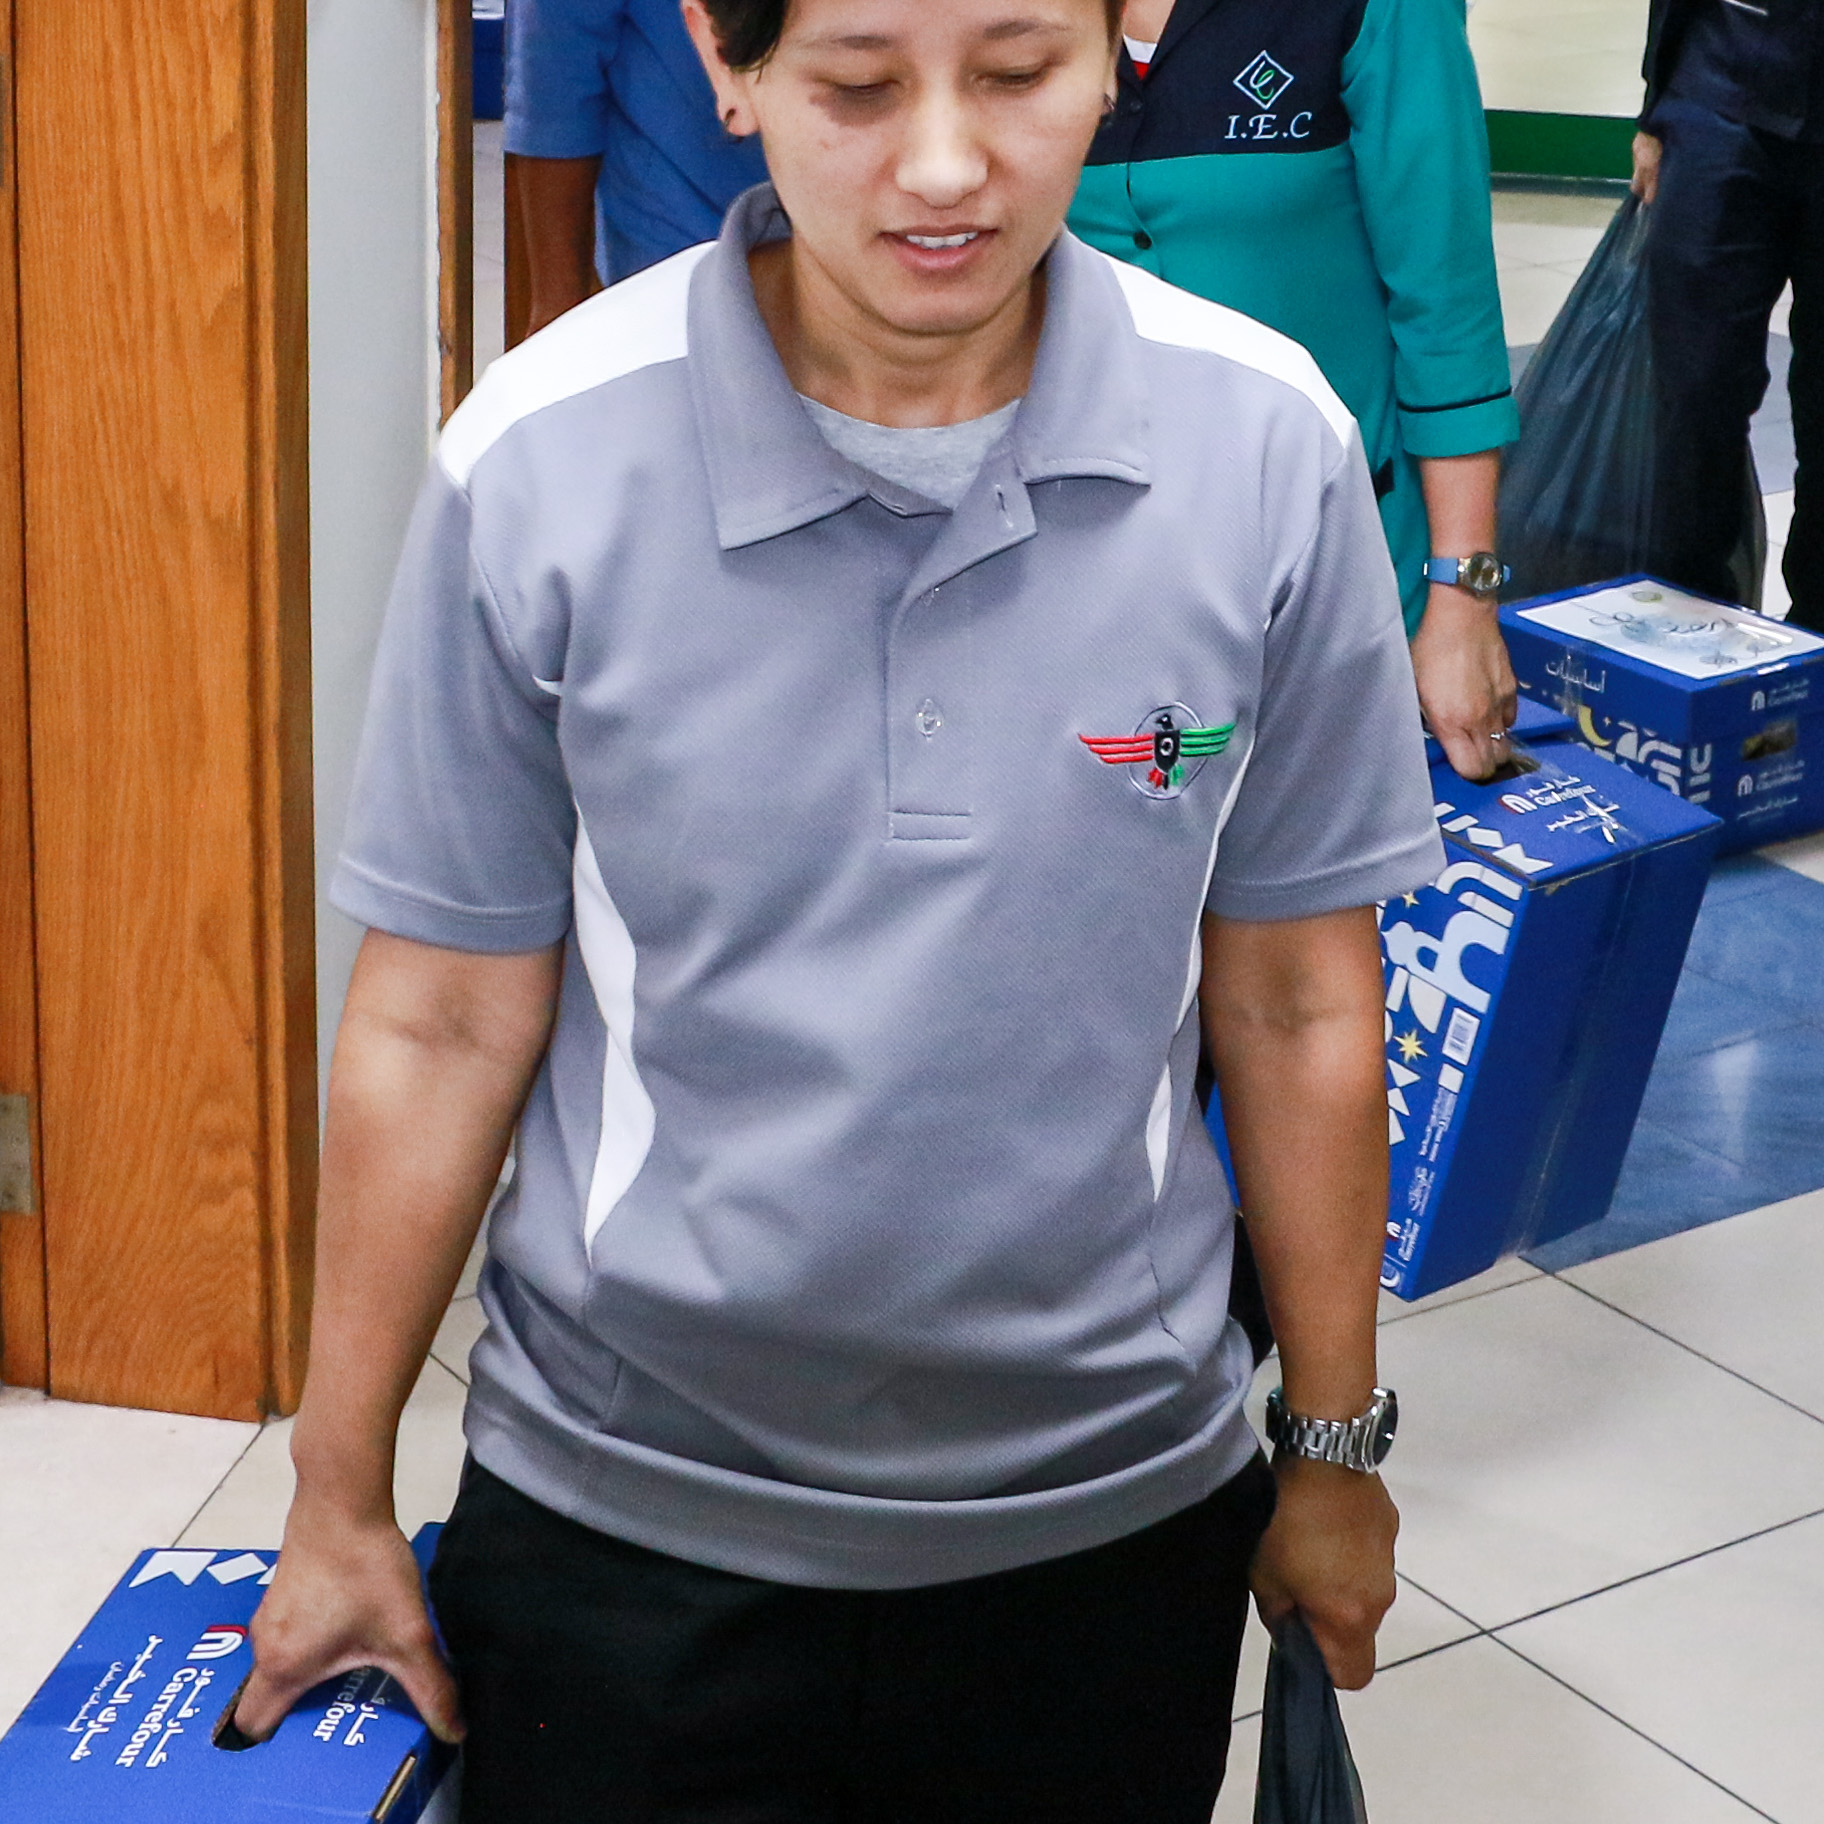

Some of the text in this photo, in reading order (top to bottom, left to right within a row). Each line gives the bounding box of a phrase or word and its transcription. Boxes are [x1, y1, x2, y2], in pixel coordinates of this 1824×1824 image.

[1224, 110, 1313, 139] I.E.C
[115, 1667, 198, 1767] Carrefour
[313, 1667, 371, 1742] rrefour
